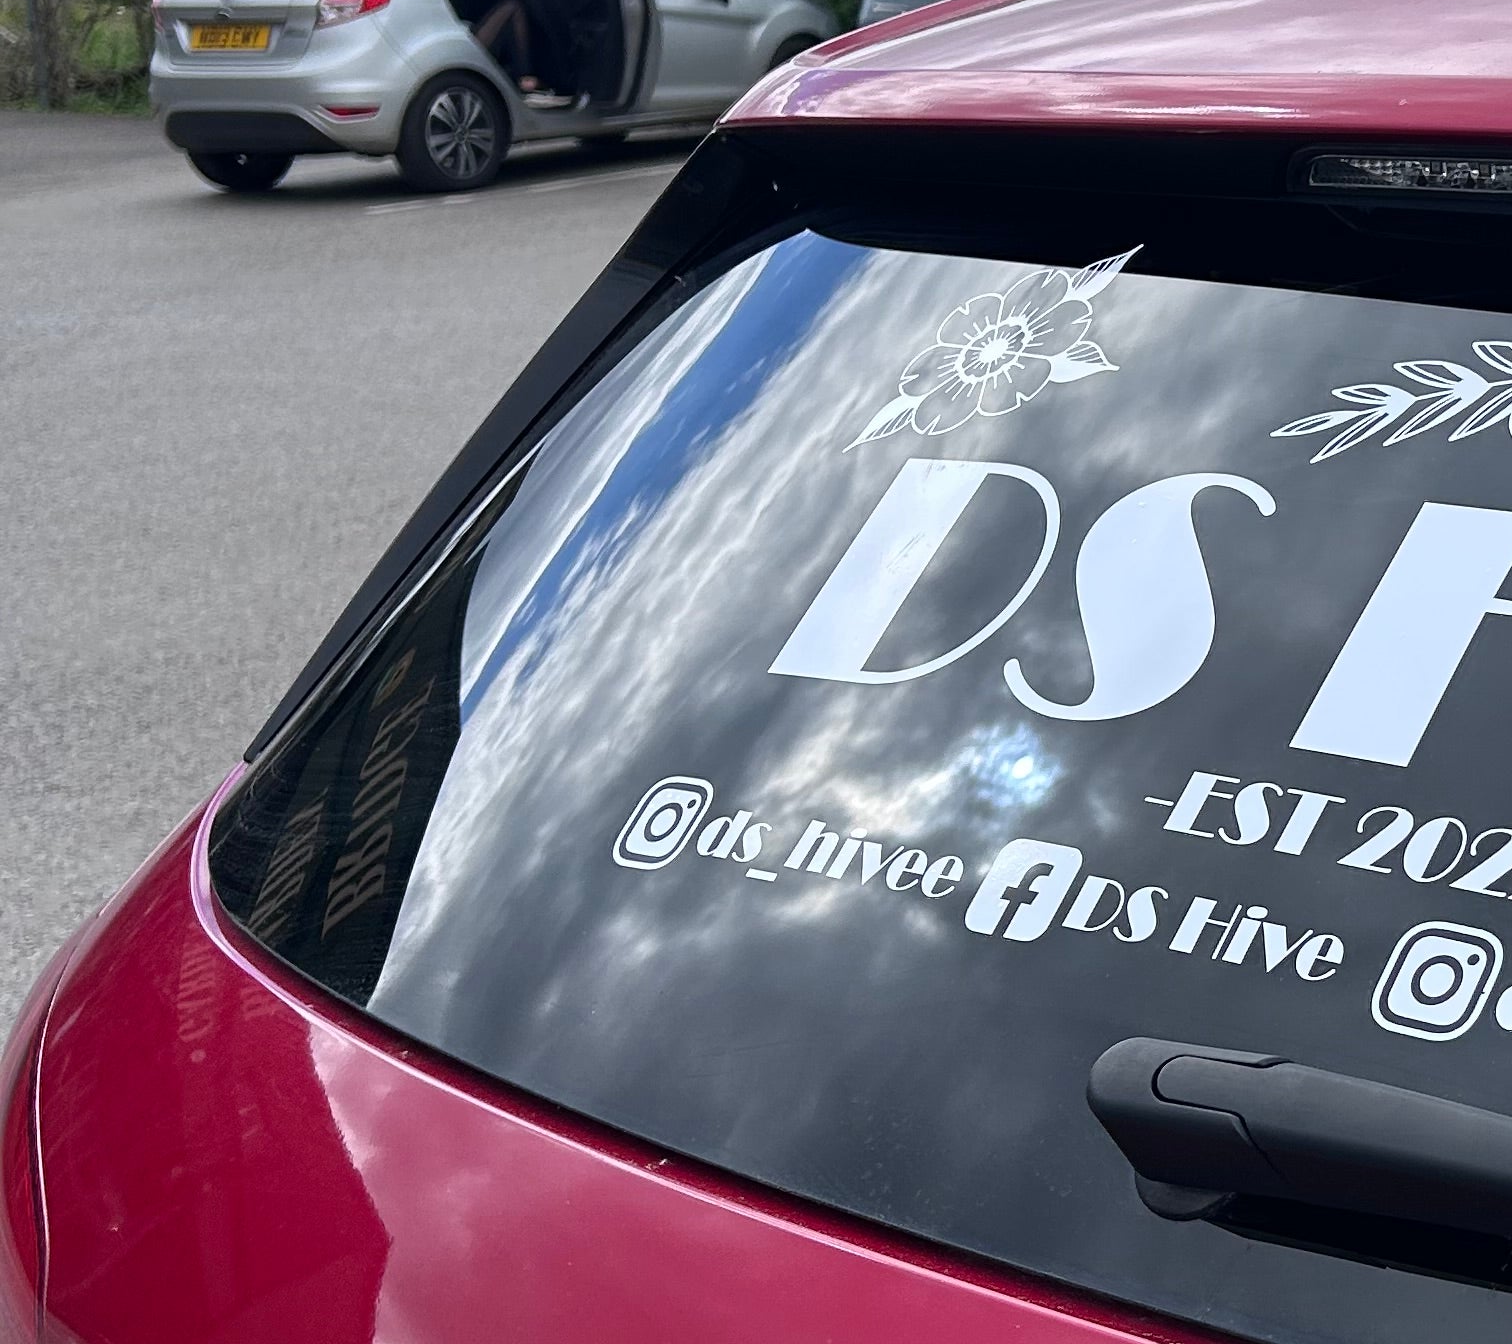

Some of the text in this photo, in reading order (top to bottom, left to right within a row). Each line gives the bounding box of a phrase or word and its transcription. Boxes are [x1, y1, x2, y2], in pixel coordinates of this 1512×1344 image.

[769, 458, 1277, 721] DS
[696, 808, 964, 898] ds_hivee
[1062, 875, 1344, 981] DS Hive
